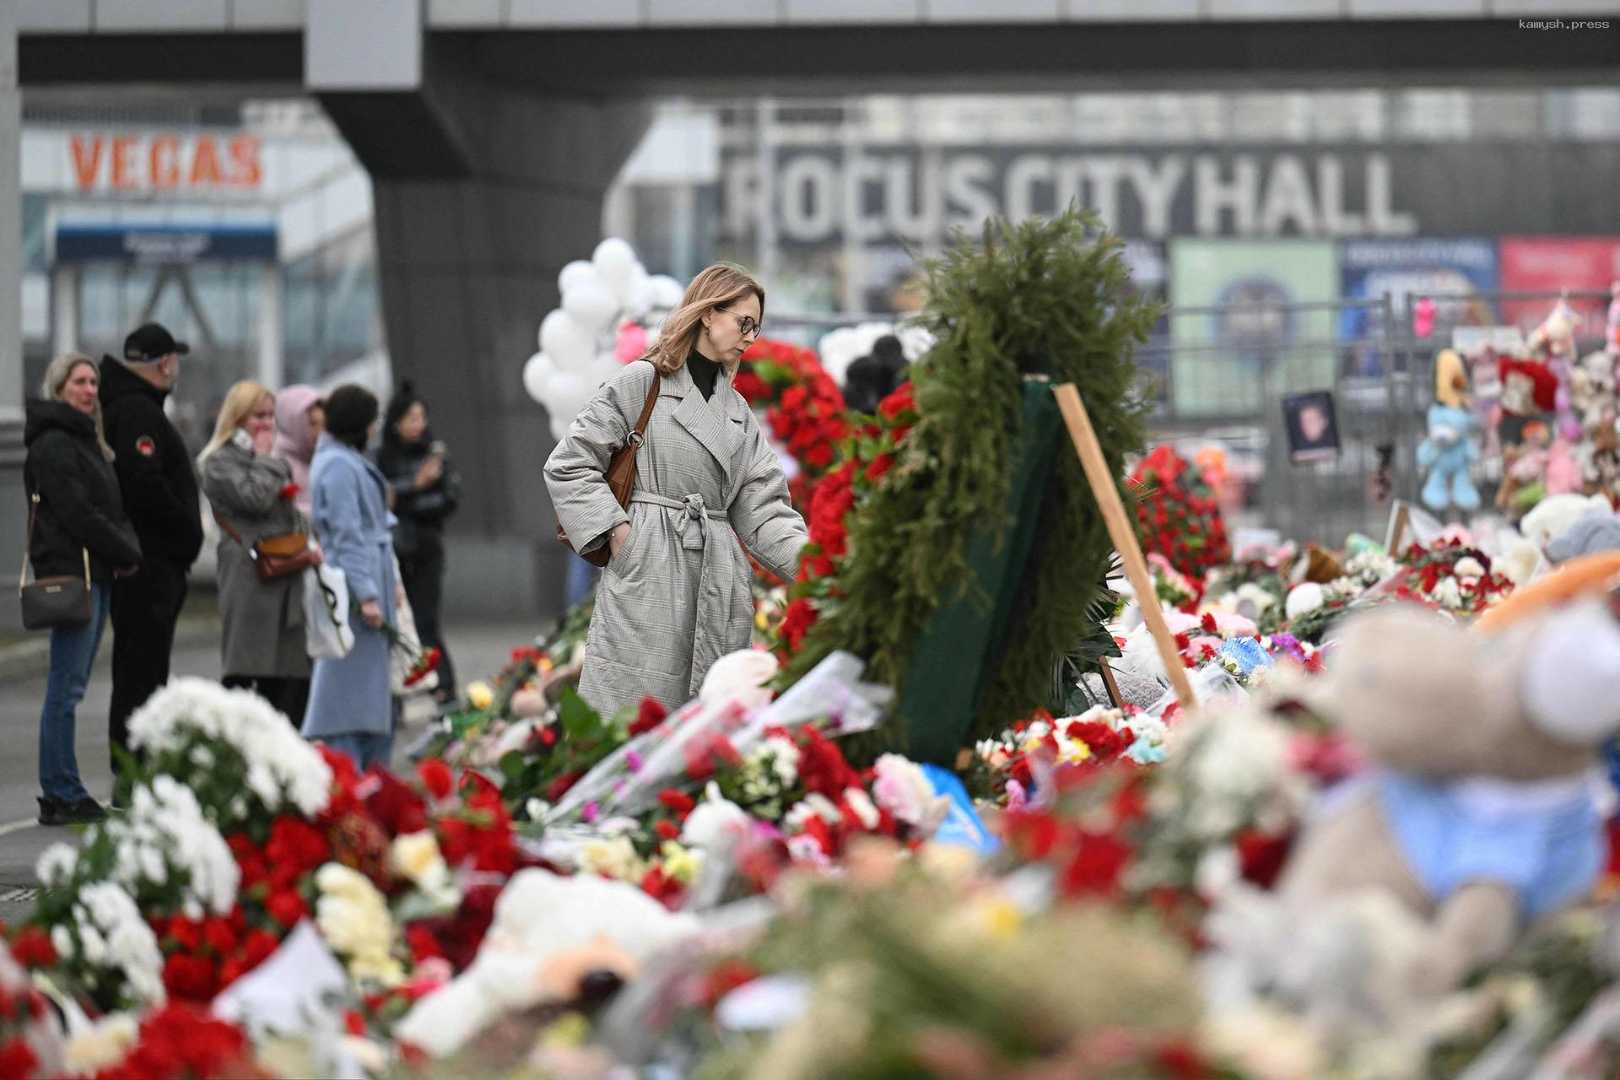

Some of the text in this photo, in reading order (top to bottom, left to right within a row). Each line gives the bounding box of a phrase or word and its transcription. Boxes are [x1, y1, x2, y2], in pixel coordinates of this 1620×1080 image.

[69, 133, 264, 189] VEGAS
[1005, 154, 1186, 236] CITY
[1195, 154, 1416, 236] HALL
